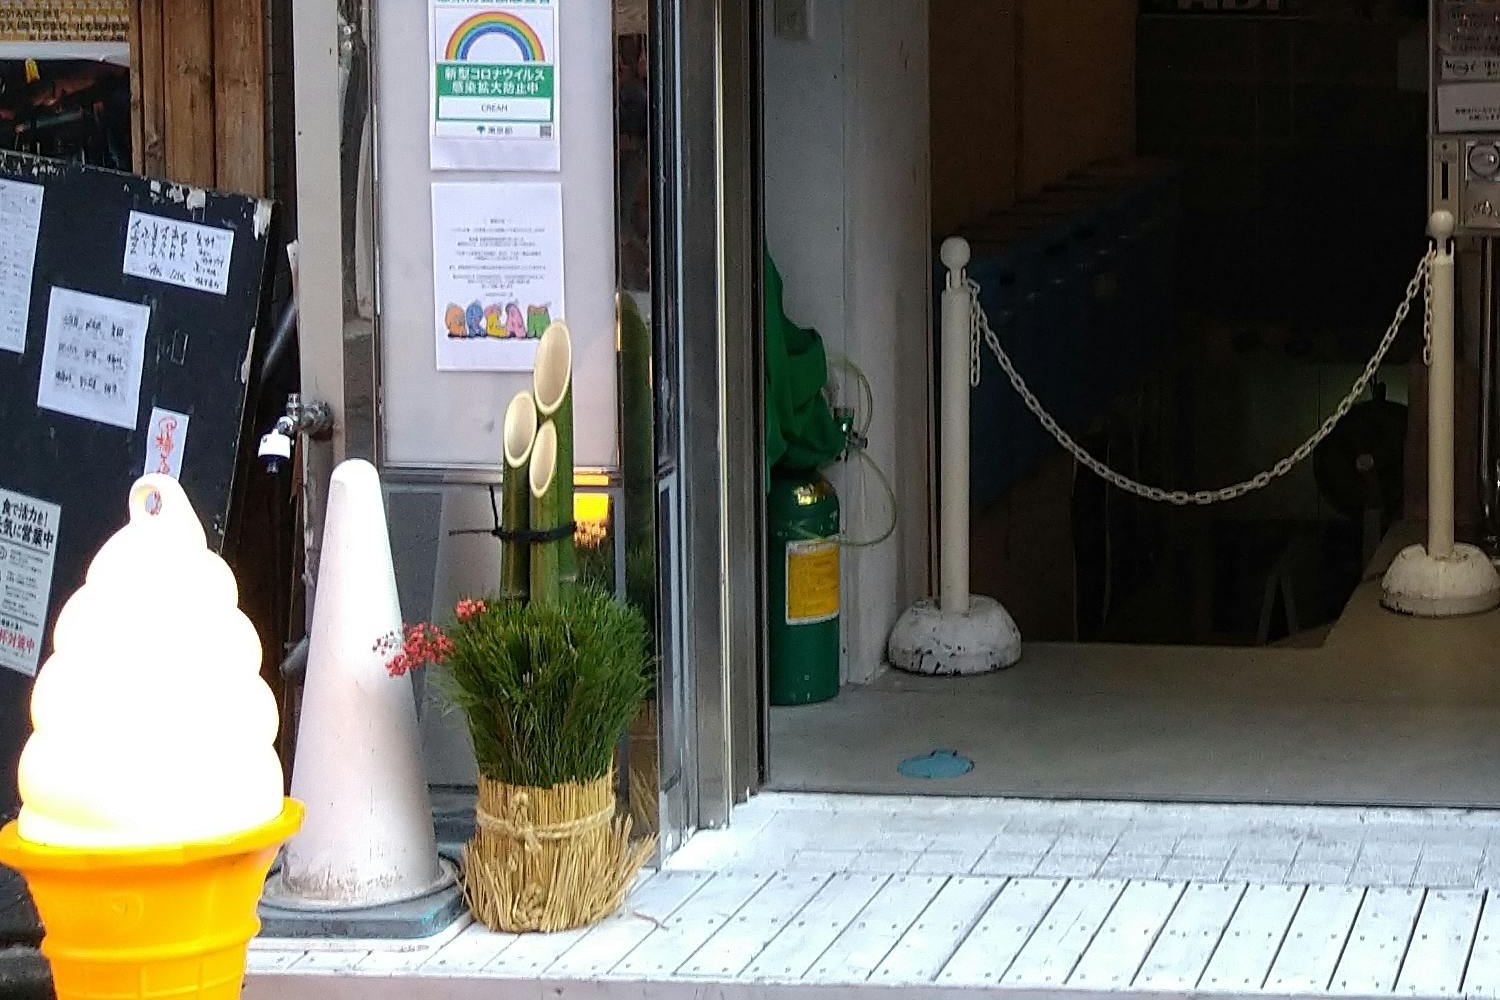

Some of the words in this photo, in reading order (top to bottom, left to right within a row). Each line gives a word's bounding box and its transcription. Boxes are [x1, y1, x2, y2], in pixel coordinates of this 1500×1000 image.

[444, 67, 545, 81] 新型コロナウイルス
[452, 80, 539, 95] 感染拡大防止中
[481, 103, 508, 113] CREAM
